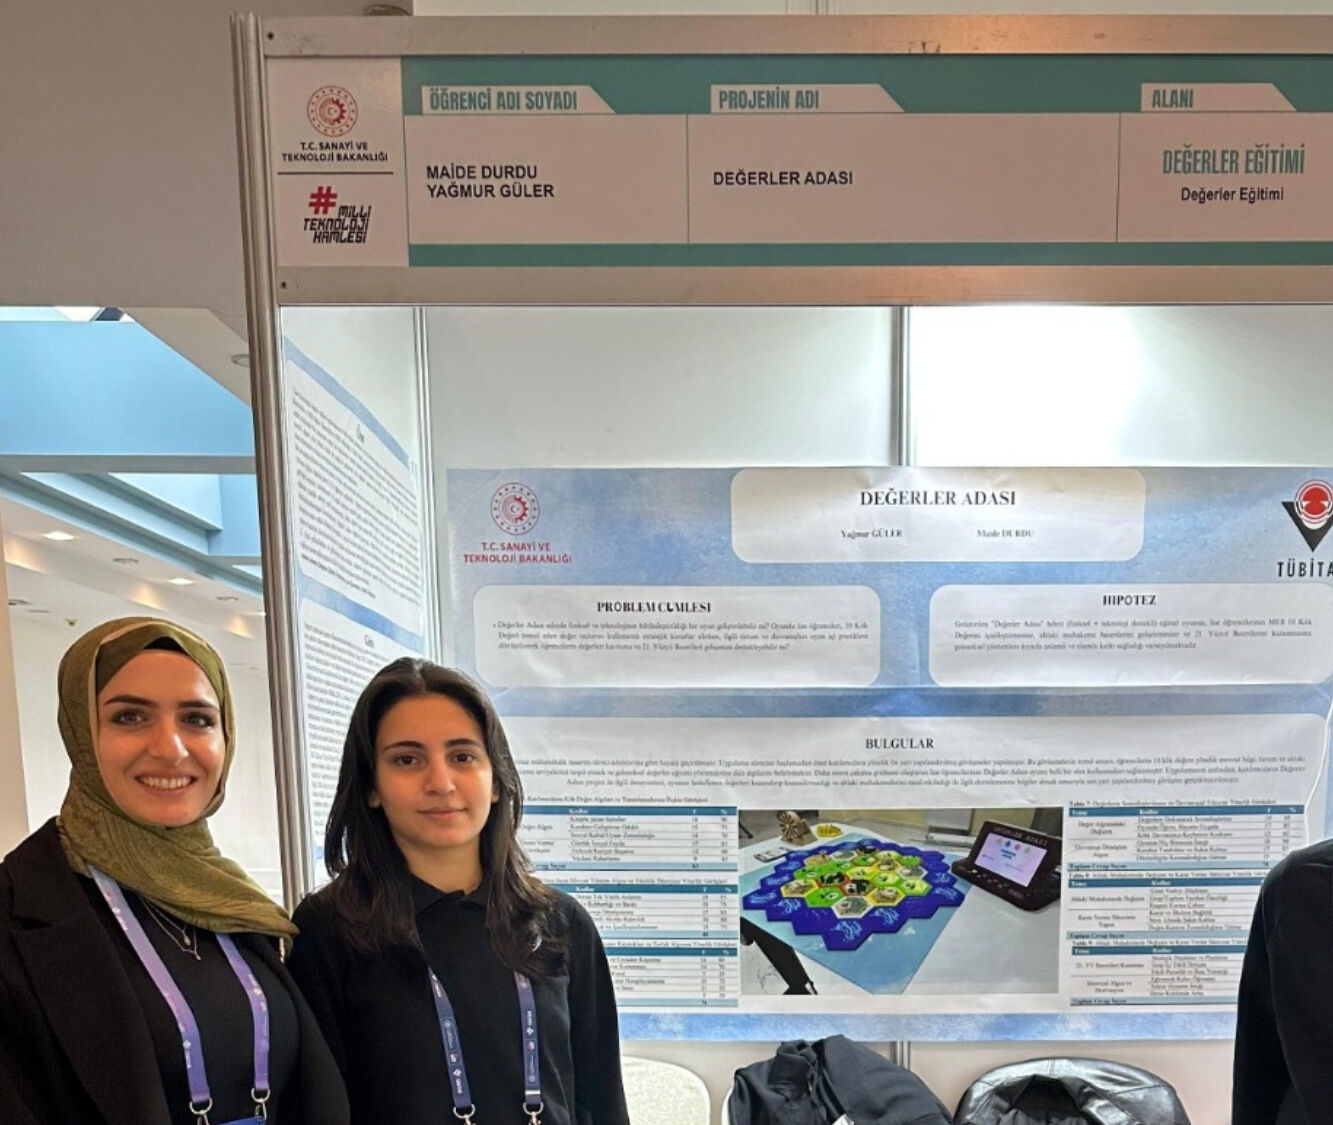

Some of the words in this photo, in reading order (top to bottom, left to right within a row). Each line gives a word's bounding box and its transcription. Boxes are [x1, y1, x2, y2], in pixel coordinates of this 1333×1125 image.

[429, 86, 492, 112] ÖĞRENCİ
[496, 88, 520, 111] ADI
[525, 88, 577, 110] SOYADI
[719, 85, 790, 110] PROJENİN
[794, 88, 819, 109] ADI
[1152, 89, 1193, 109] ALANI
[301, 142, 317, 151] T.C.
[319, 141, 353, 150] SANAYİ
[356, 142, 368, 150] VE
[282, 152, 334, 161] TEKNOLOJİ
[336, 152, 387, 161] BAKANLIĞI
[1162, 142, 1239, 175] DEĞERLER
[1245, 142, 1305, 174] EĞİTİMİ
[426, 163, 477, 181] MAİDE
[481, 165, 537, 180] DURDU
[713, 168, 800, 187] DEĞERLER
[804, 171, 853, 185] ADASI
[426, 180, 496, 199] YAĞMUR
[500, 181, 554, 198] GÜLER
[1181, 187, 1236, 204] Değerler
[1240, 187, 1284, 204] Eğitimi
[303, 218, 369, 231] TEKNOLOJİ
[313, 231, 367, 243] HAMLESİ
[860, 488, 957, 506] DEĞERLER
[961, 490, 1016, 506] ADASI
[481, 543, 498, 551] T.C.
[500, 541, 535, 551] SANAYİ
[538, 542, 551, 551] VE
[464, 553, 516, 564] TEKNOLOJİ
[519, 552, 572, 563] BAKANLIĞI
[597, 601, 655, 613] PROBLEM
[865, 738, 934, 750] BULGULAR
